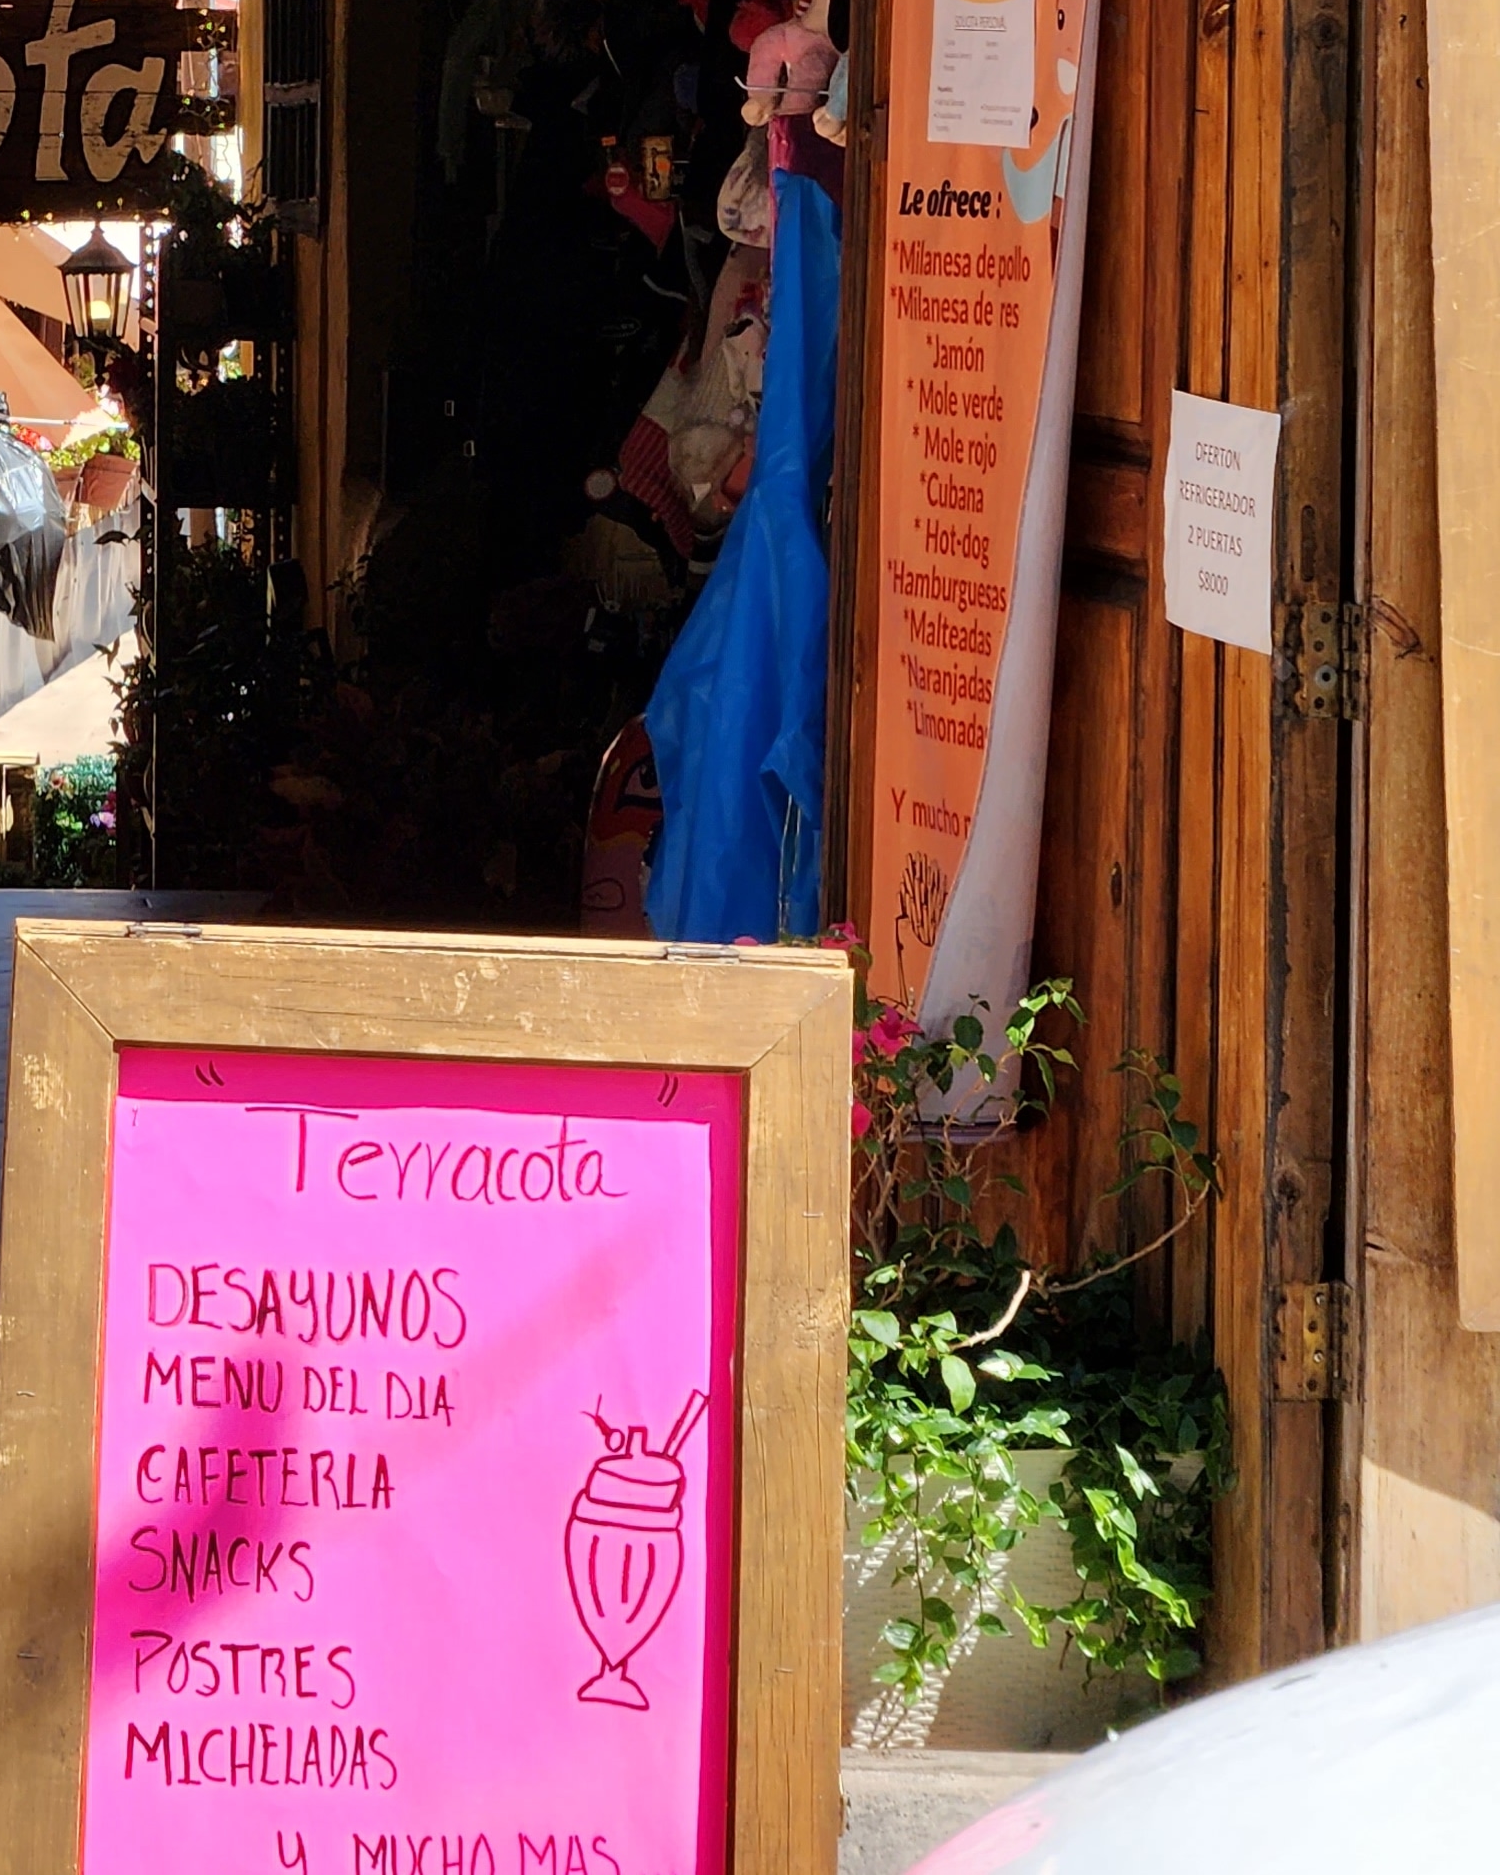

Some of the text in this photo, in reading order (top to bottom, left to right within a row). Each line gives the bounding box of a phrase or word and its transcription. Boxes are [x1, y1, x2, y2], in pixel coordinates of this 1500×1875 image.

[899, 179, 992, 219] Le ofrece
[975, 243, 995, 280] de
[998, 245, 1031, 287] pollo
[973, 289, 993, 327] de
[1000, 300, 1020, 329] res
[932, 333, 985, 373] Jamón
[918, 378, 1004, 422] Mole verde
[923, 426, 997, 475] Mole rojo
[1195, 441, 1241, 472] OFERTON
[926, 472, 985, 513] Cubana
[1179, 479, 1256, 518] REFRIGERADOR
[925, 518, 990, 570] Hot-dog
[1187, 524, 1243, 557] 2 PUERTAS
[892, 560, 1007, 613] Hamburguesas
[1198, 568, 1229, 597] $8000
[909, 608, 992, 658] Malteadas
[906, 653, 992, 704] Naranjadas
[913, 701, 988, 751] Limonada
[891, 787, 907, 823] Y
[912, 797, 960, 837] mucho
[244, 1102, 629, 1205] Terracota
[147, 1262, 468, 1348] DESAYUNOS
[143, 1349, 456, 1426] MENU DEL DIA
[136, 1443, 395, 1511] CAFETERIA
[127, 1525, 315, 1603] SNACKS
[130, 1628, 357, 1709] POSTRES
[124, 1721, 398, 1790] MICHELADAS
